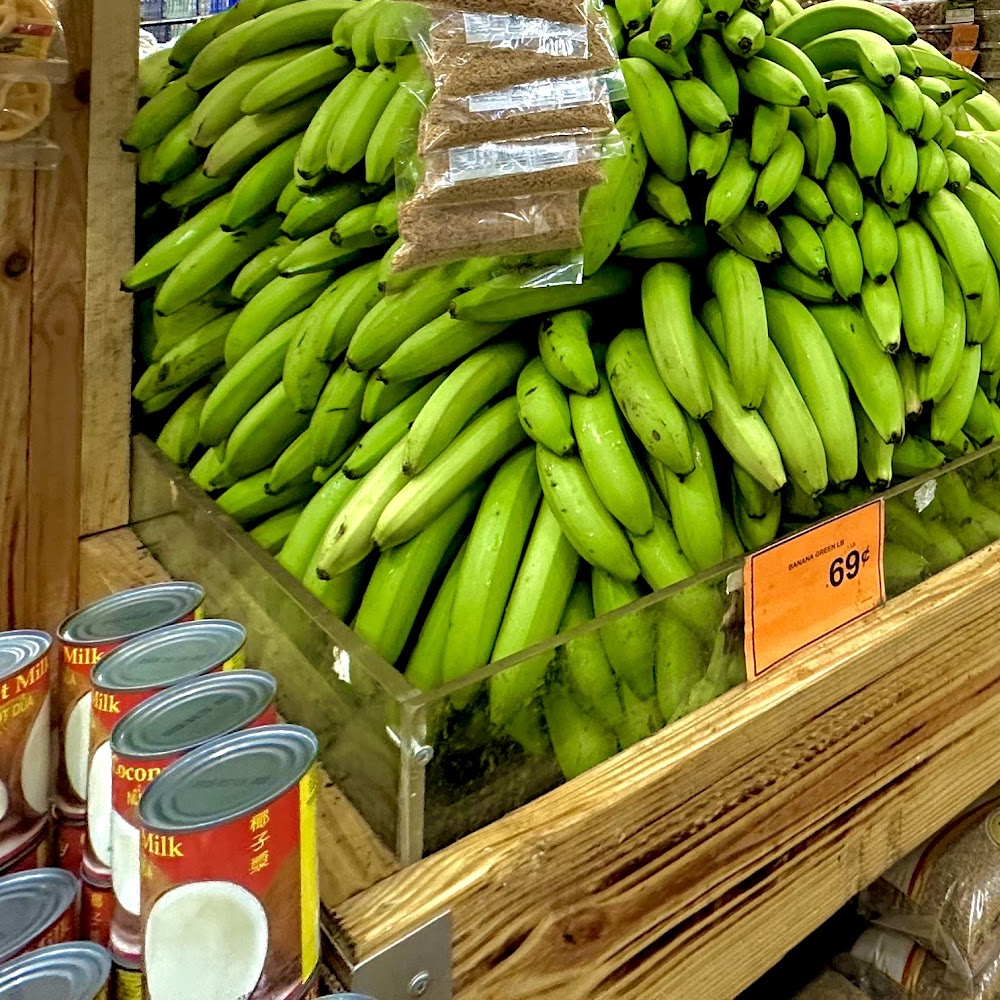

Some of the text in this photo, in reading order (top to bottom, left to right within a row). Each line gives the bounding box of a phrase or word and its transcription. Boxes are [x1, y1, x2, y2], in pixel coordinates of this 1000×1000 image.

[788, 539, 845, 571] BANANA GREEN LB
[63, 646, 106, 665] Milk
[141, 827, 184, 858] Milk
